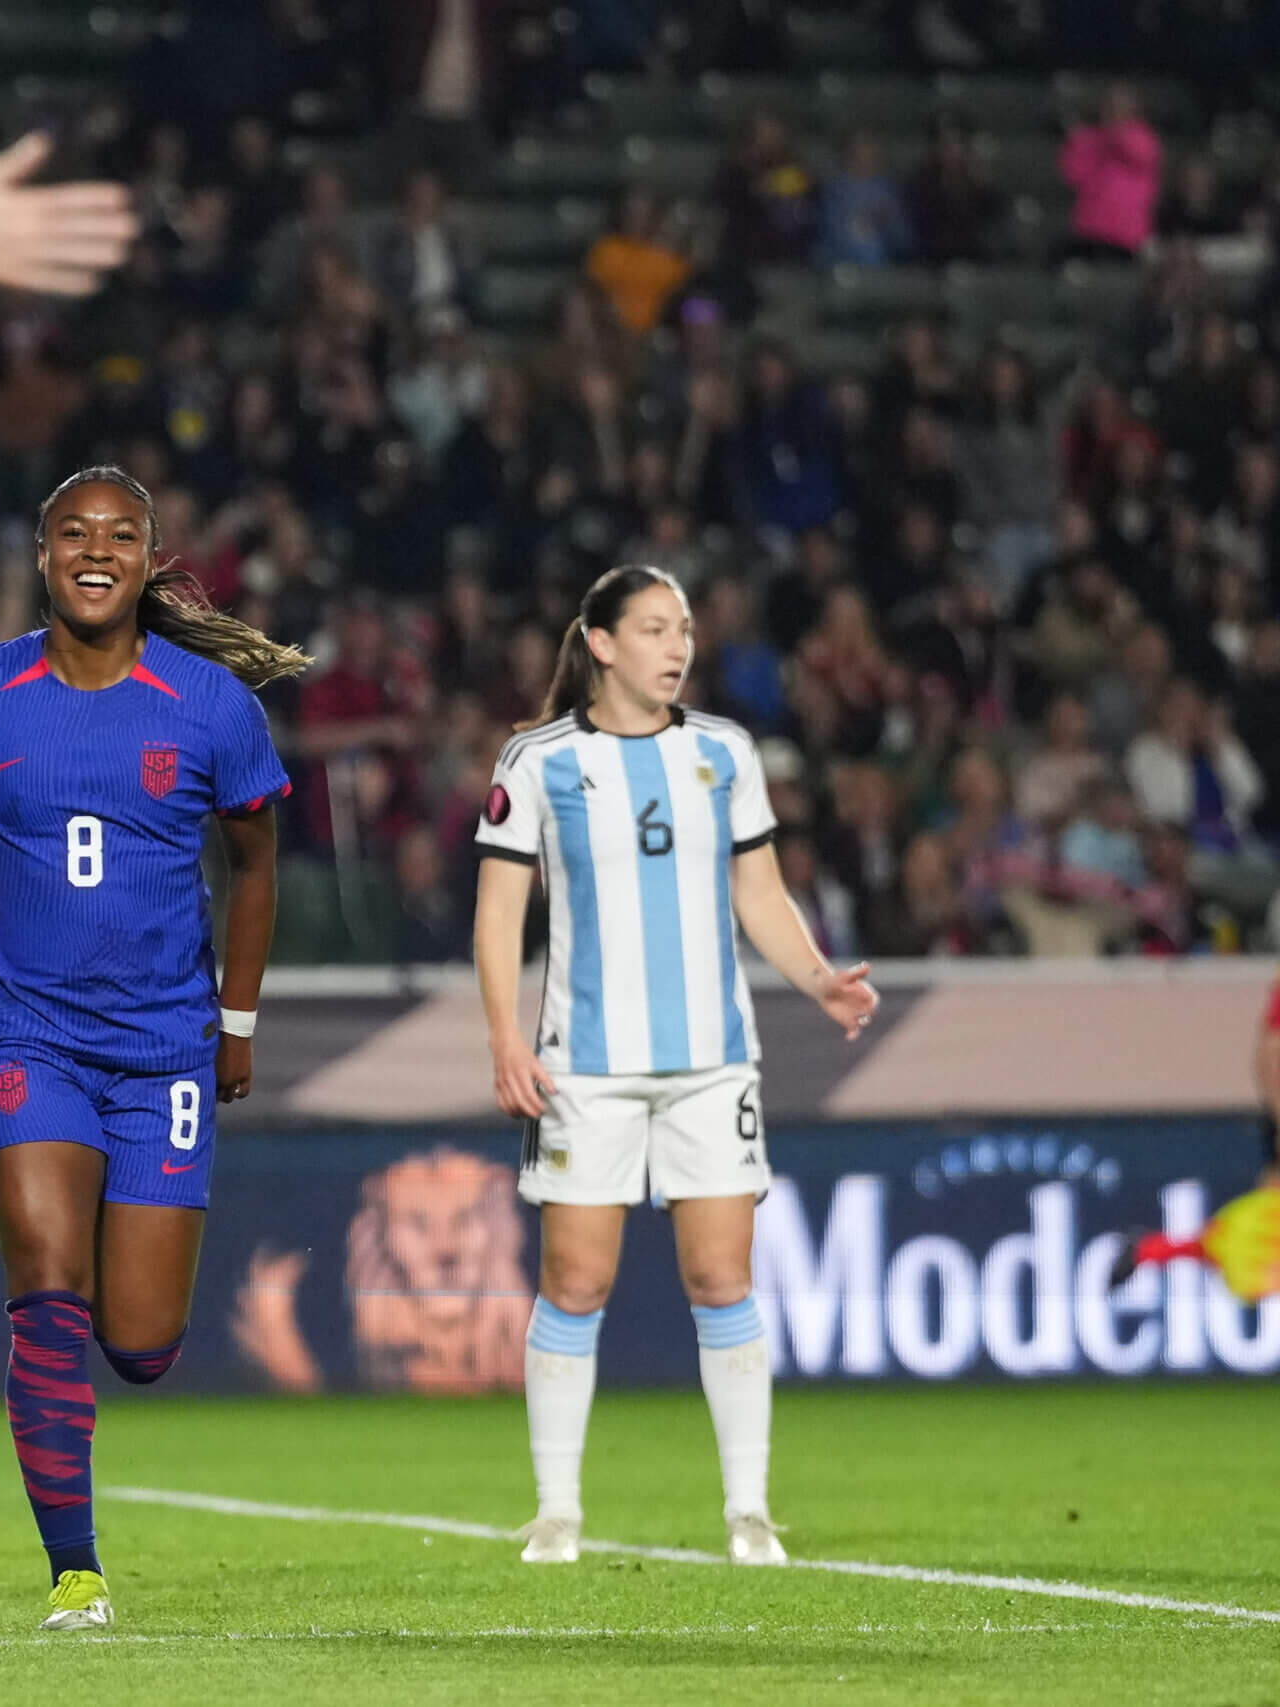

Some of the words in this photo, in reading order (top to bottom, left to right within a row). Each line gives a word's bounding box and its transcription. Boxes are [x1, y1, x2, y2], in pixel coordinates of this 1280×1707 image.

[144, 752, 175, 771] USA
[66, 815, 103, 888] 8
[638, 798, 673, 856] 6
[169, 1080, 200, 1150] 8
[736, 1080, 758, 1141] 6
